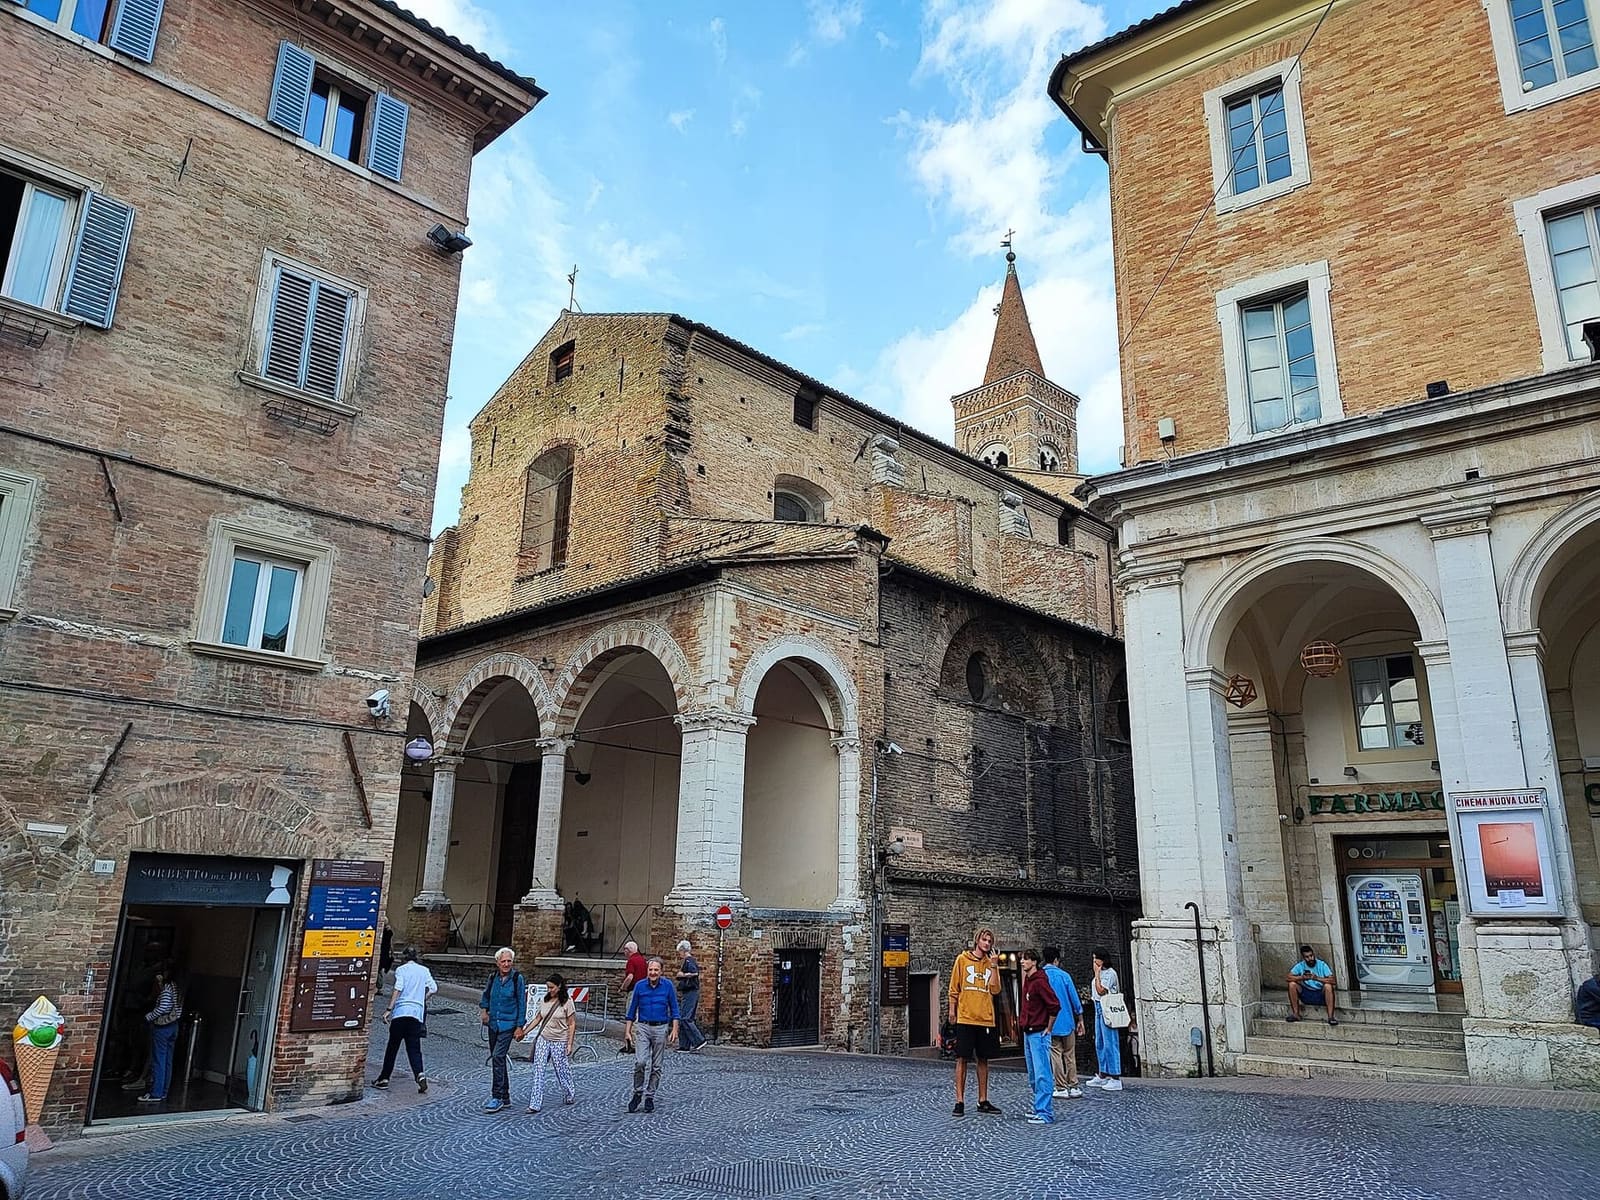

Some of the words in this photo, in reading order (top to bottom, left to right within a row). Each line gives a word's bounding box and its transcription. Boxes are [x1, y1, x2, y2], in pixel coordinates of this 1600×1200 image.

[1456, 797, 1486, 807] CINEMA
[1489, 796, 1517, 806] NUOVA
[1518, 795, 1540, 805] LUCE
[140, 868, 209, 880] SORBETTO
[229, 871, 262, 881] DUCA
